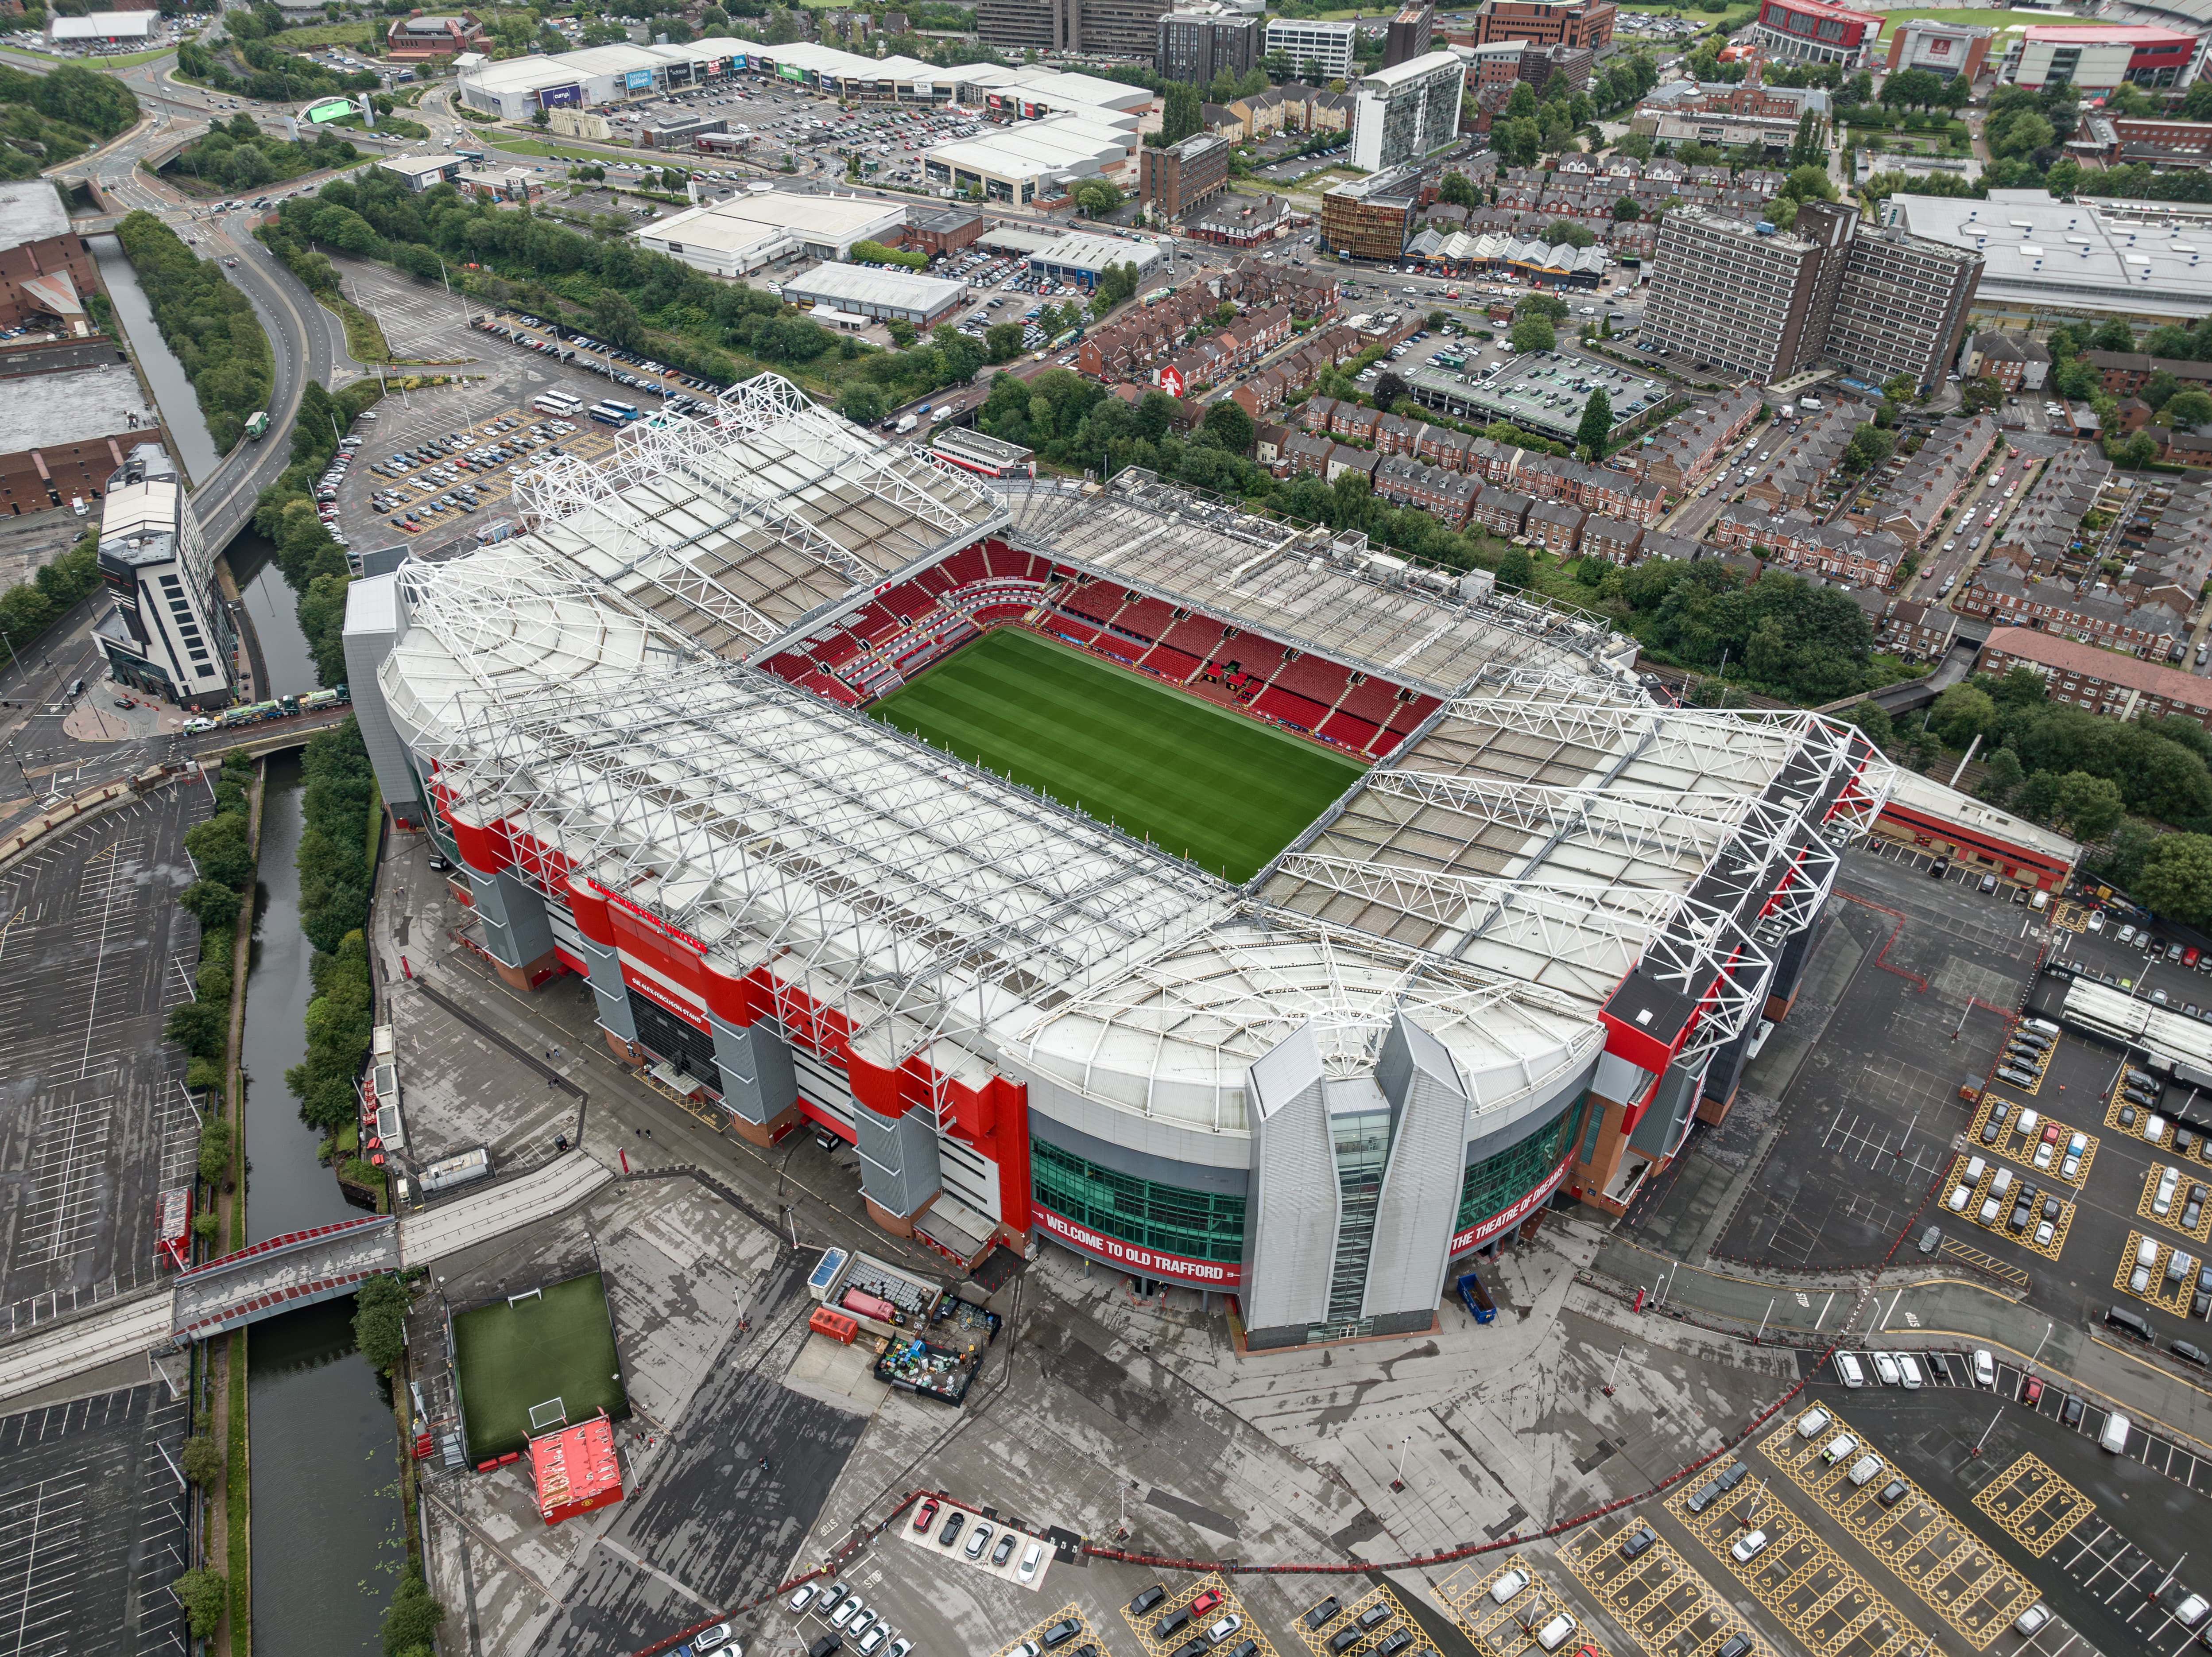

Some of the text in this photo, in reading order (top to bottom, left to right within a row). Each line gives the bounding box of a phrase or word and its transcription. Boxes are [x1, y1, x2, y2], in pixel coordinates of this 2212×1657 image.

[783, 66, 798, 75] wren
[630, 77, 649, 86] Village
[1191, 606, 1209, 617] BOBBY
[1211, 612, 1241, 629] CHARLTON
[1244, 625, 1263, 636] STAND
[586, 877, 708, 954] MANCHESTER UNITED
[632, 978, 701, 1024] SIR ALEX FERGUSON STAND
[701, 1114, 717, 1125] PARKING
[1452, 1164, 1565, 1250] THE THEATRE OF DREAMS
[1046, 1214, 1223, 1280] WELCOME TO OLD TRAFFORD
[1796, 1292, 1809, 1307] STOP
[1905, 1312, 1920, 1327] STOP
[820, 1518, 838, 1537] STOP
[864, 1569, 883, 1589] STOP
